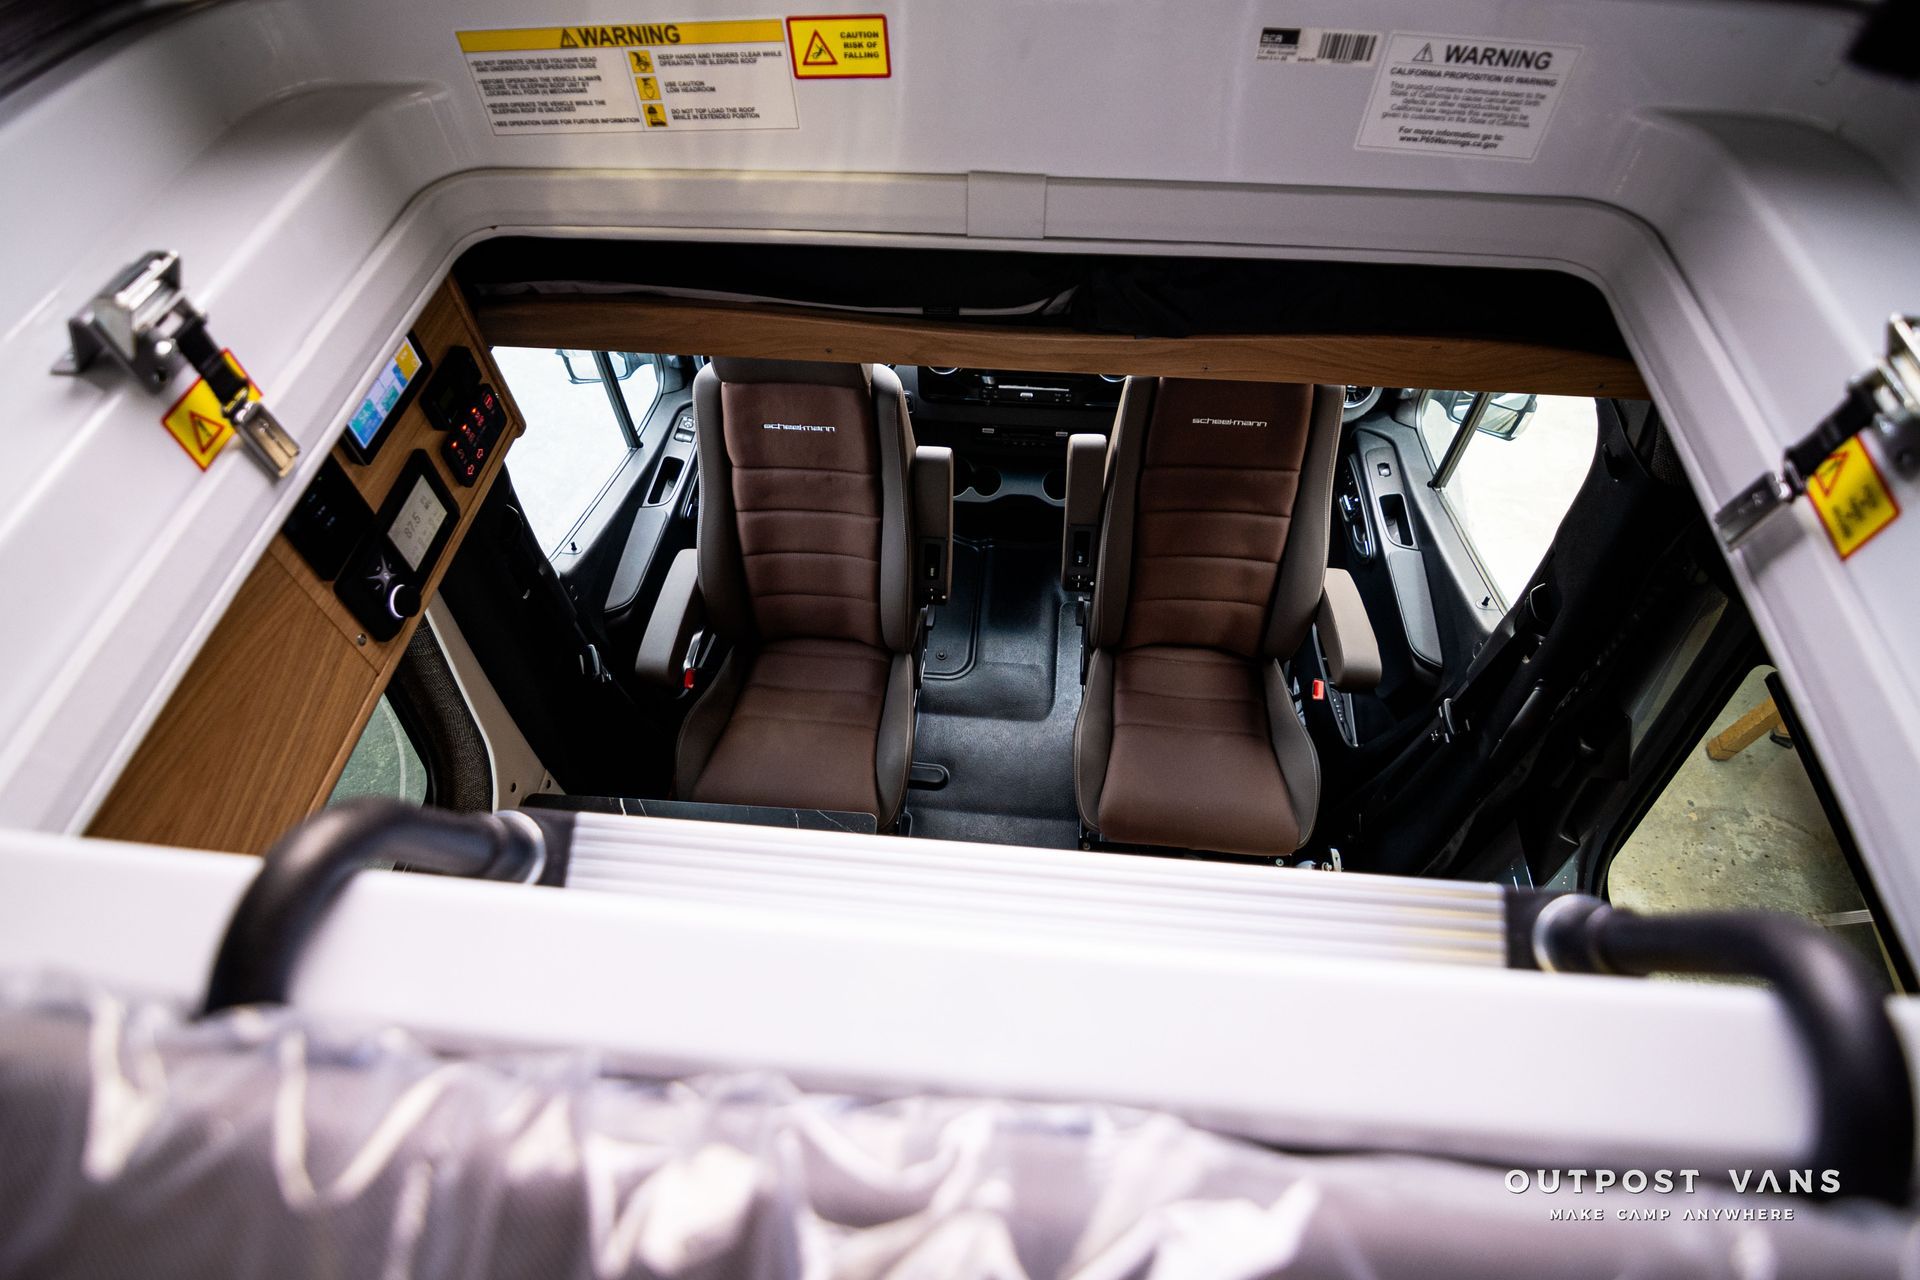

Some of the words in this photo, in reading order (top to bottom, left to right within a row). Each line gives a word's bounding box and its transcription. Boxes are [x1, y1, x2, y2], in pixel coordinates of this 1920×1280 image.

[576, 25, 680, 46] WARNING
[1444, 44, 1553, 70] WARNING
[1390, 67, 1442, 77] CALIFORNIA
[1444, 70, 1503, 82] PROPOSITION
[1504, 75, 1515, 83] 65
[1516, 77, 1557, 87] WARNING
[1435, 129, 1480, 138] information
